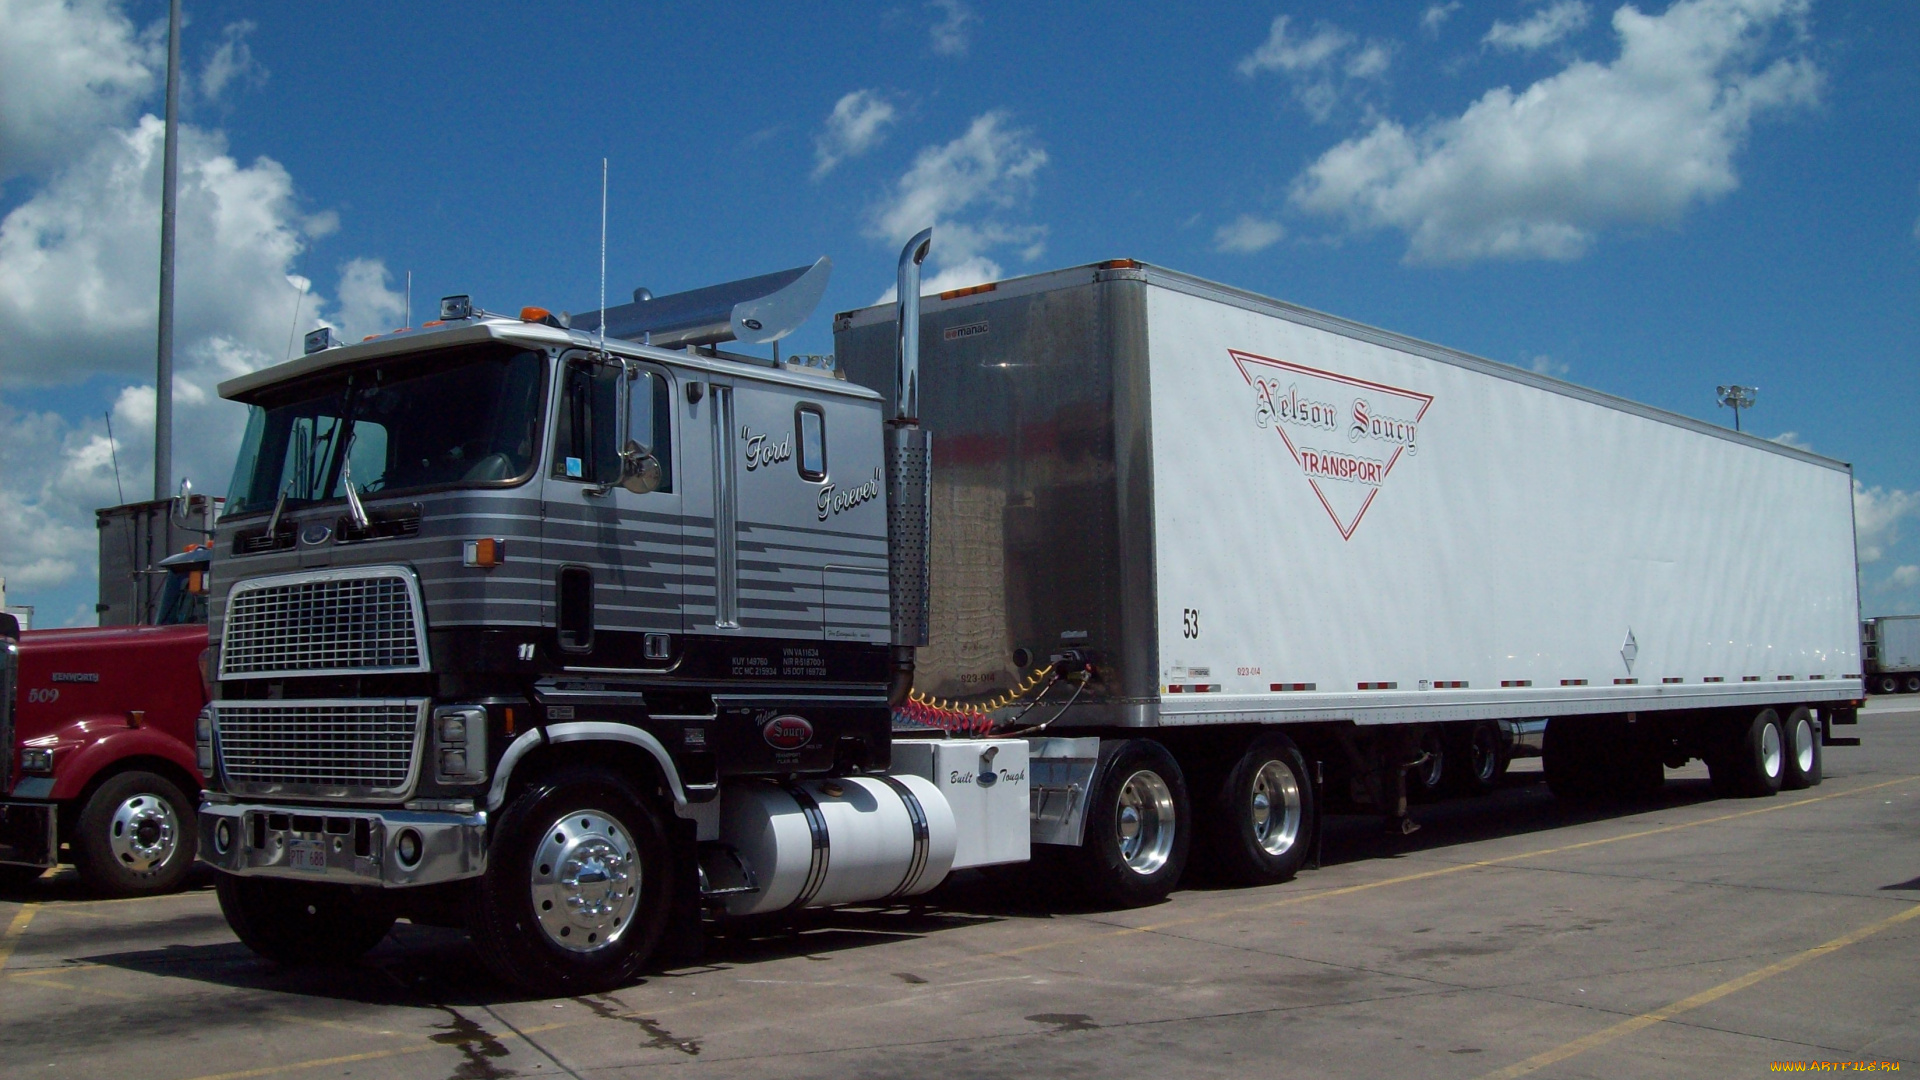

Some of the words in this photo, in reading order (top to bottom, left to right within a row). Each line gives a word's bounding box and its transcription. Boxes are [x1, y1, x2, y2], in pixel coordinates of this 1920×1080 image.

[1254, 377, 1336, 429] Nelson
[1350, 400, 1417, 454] Soucy
[1301, 451, 1382, 483] TRANSPORT
[783, 648, 793, 656] VIN
[744, 667, 754, 675] MC
[783, 667, 792, 675] US
[793, 667, 804, 675] DOT
[950, 770, 973, 784] Built
[999, 768, 1026, 786] Tough
